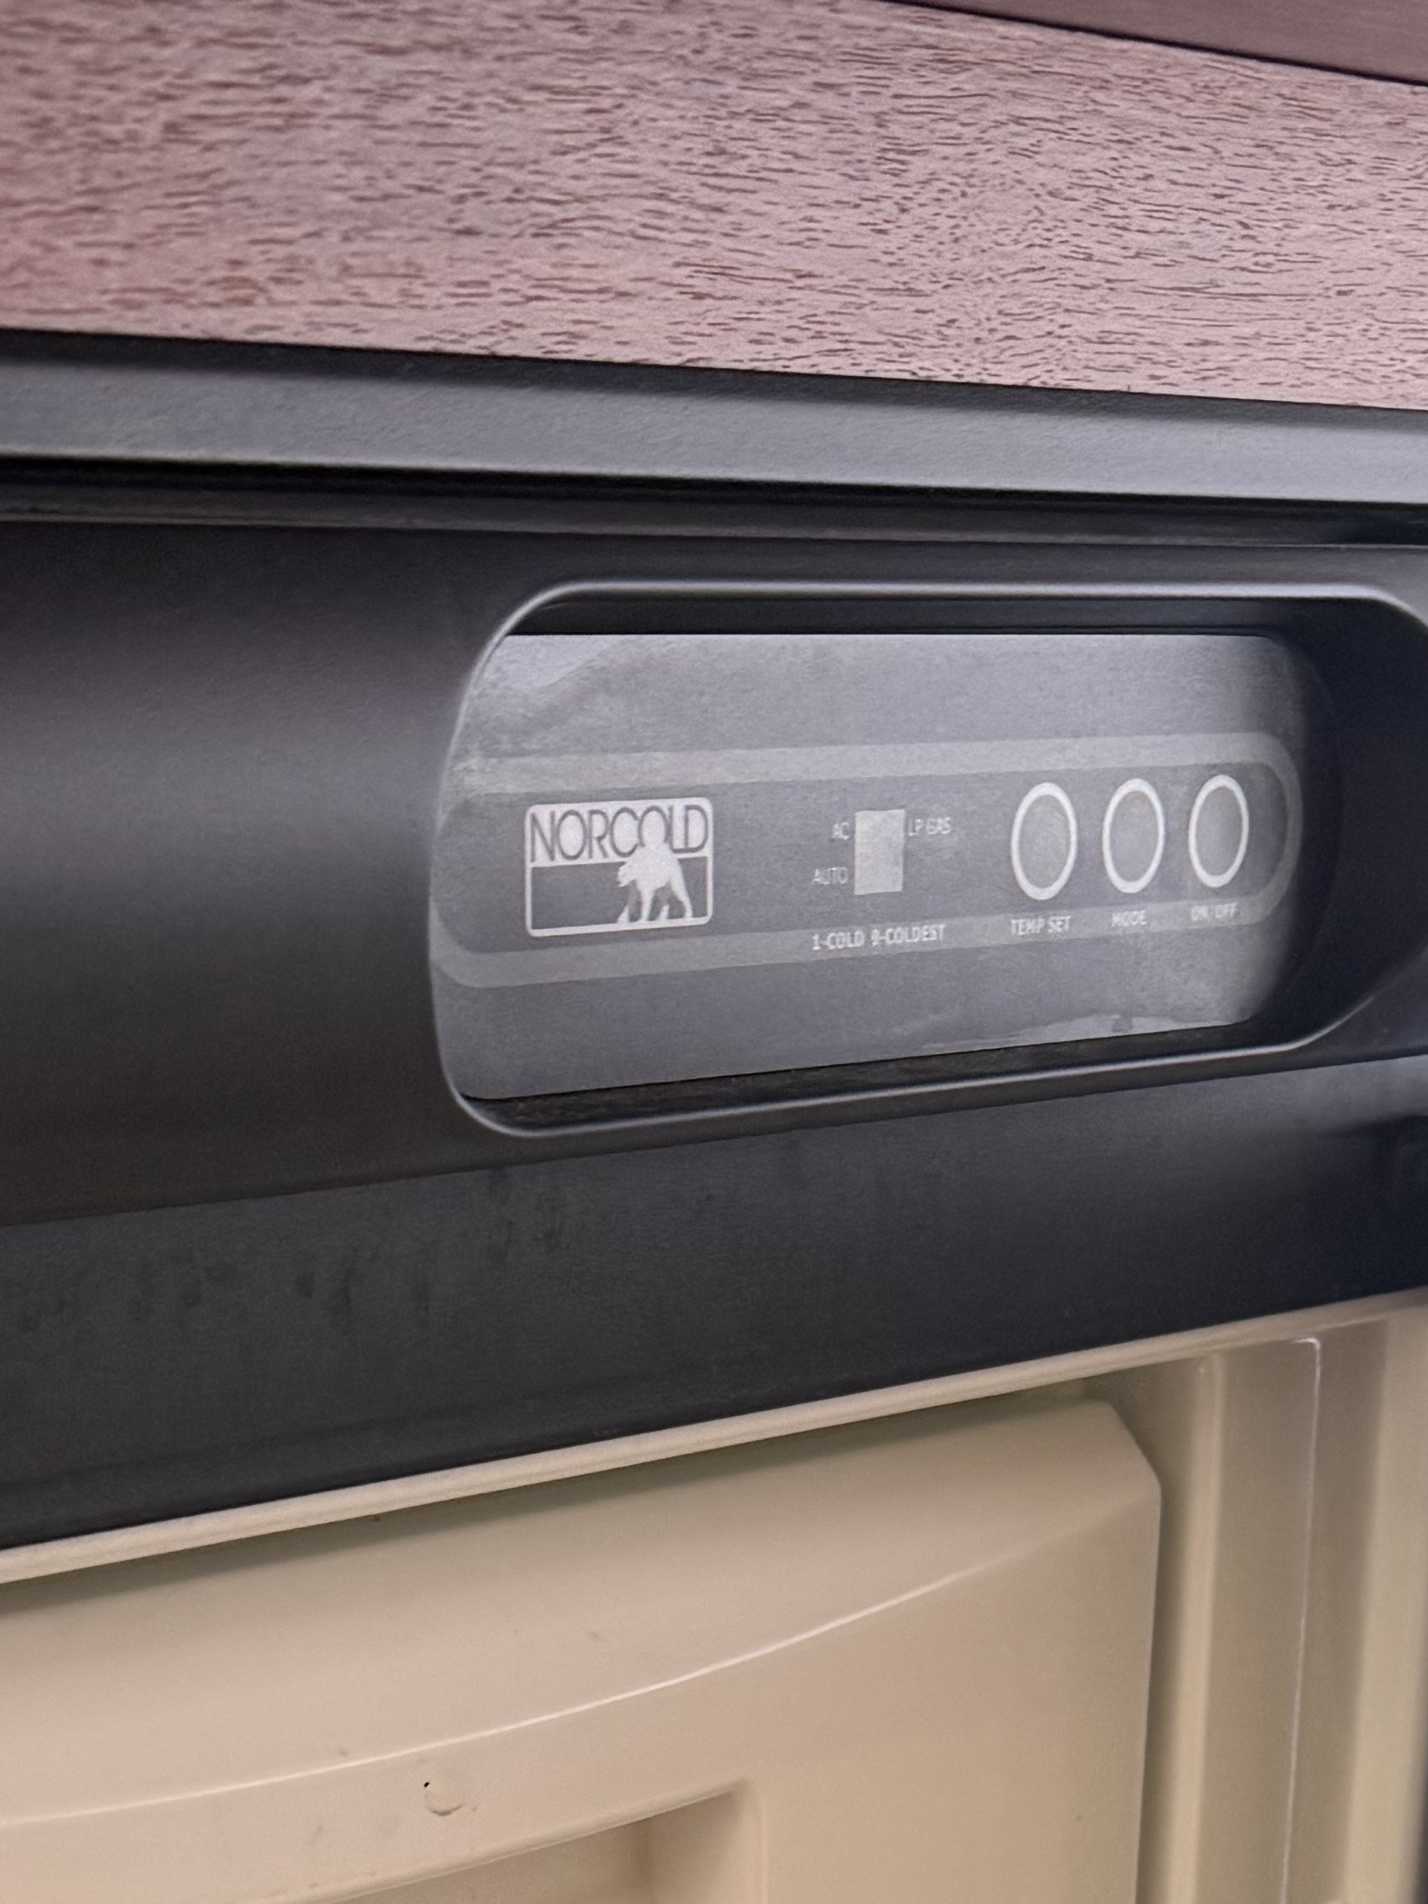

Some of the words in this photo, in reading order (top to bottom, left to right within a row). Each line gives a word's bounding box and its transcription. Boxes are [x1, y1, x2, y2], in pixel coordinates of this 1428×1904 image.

[529, 803, 710, 863] NORCOLD
[831, 821, 850, 841] AC
[907, 818, 923, 837] LP
[812, 866, 849, 885] AUTO
[1010, 916, 1045, 936] TEMP
[1047, 914, 1072, 934] SET
[1111, 909, 1147, 928] MODE
[811, 930, 865, 951] 1-COLD
[870, 923, 947, 947] 9-COLDEST
